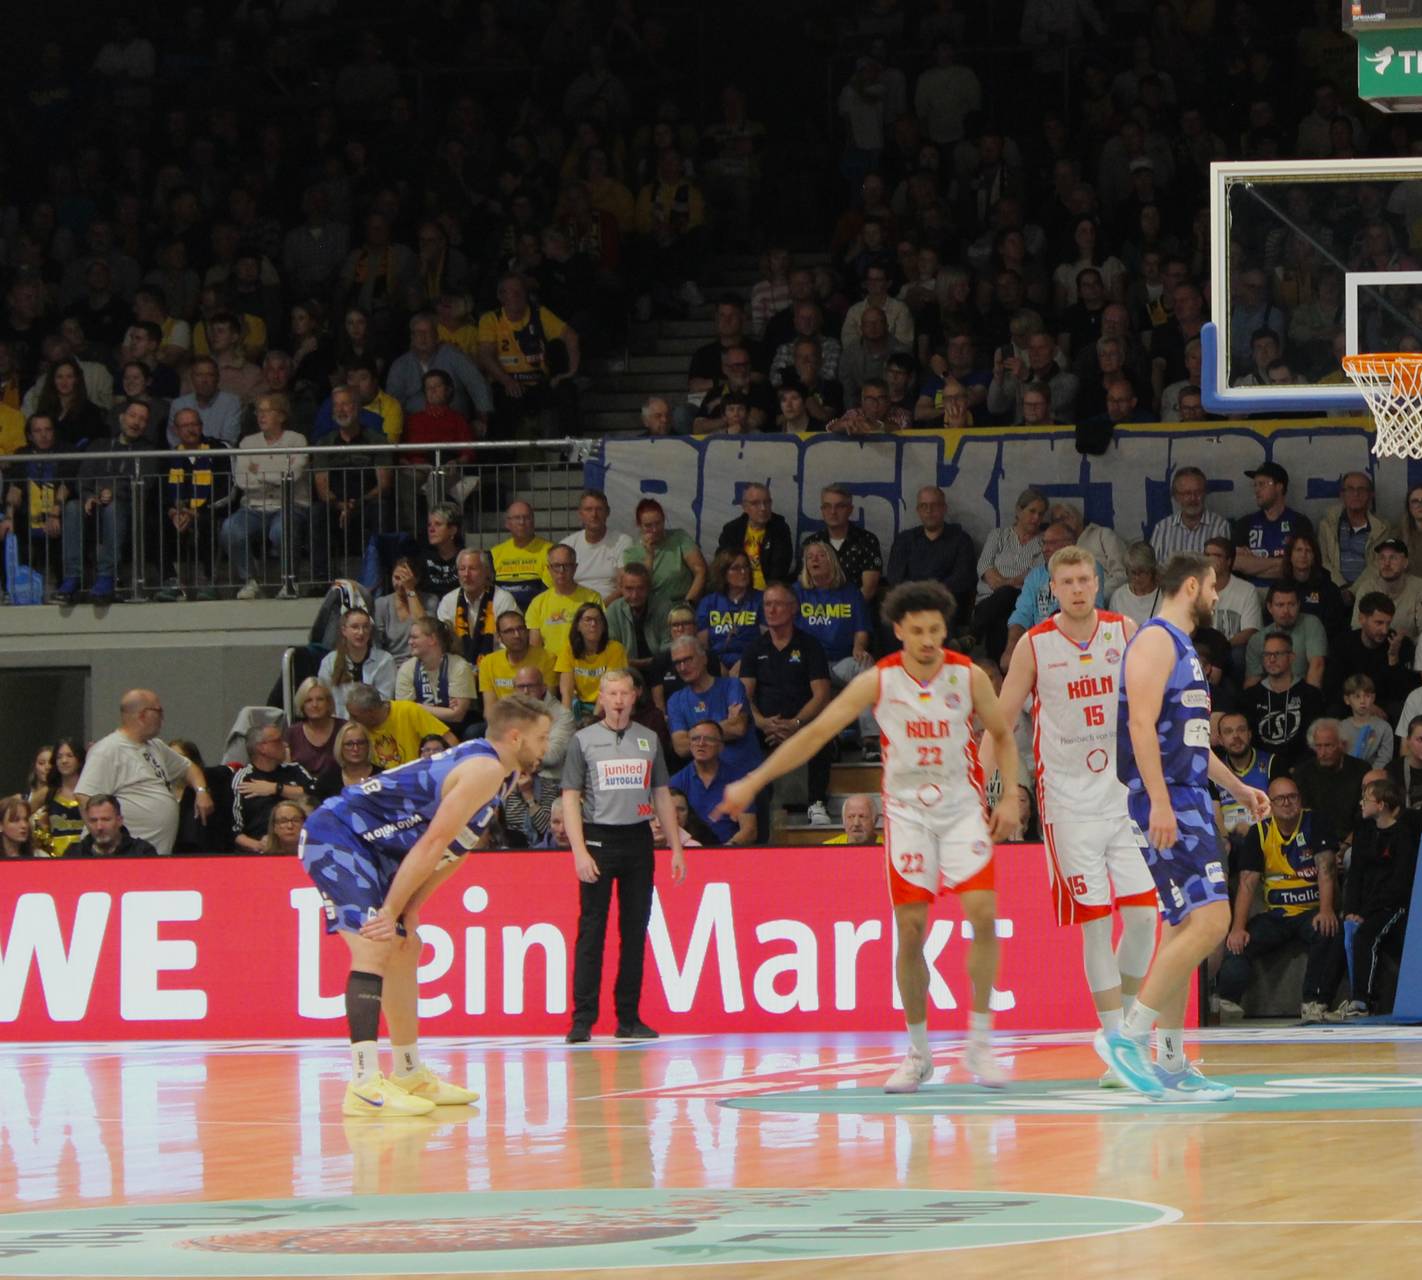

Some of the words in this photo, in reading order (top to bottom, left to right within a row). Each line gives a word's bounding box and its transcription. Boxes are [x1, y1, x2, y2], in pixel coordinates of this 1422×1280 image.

[708, 610, 757, 626] GAME
[800, 602, 852, 618] GAME
[1067, 674, 1114, 700] KÖLN
[1082, 704, 1105, 727] 15
[906, 716, 950, 739] KÖLN
[917, 746, 943, 766] 22
[604, 763, 643, 777] junited
[604, 776, 643, 786] AUTOGLAS
[900, 852, 925, 874] 22
[0, 889, 208, 1022] WE
[719, 1200, 1040, 1244] Thalia
